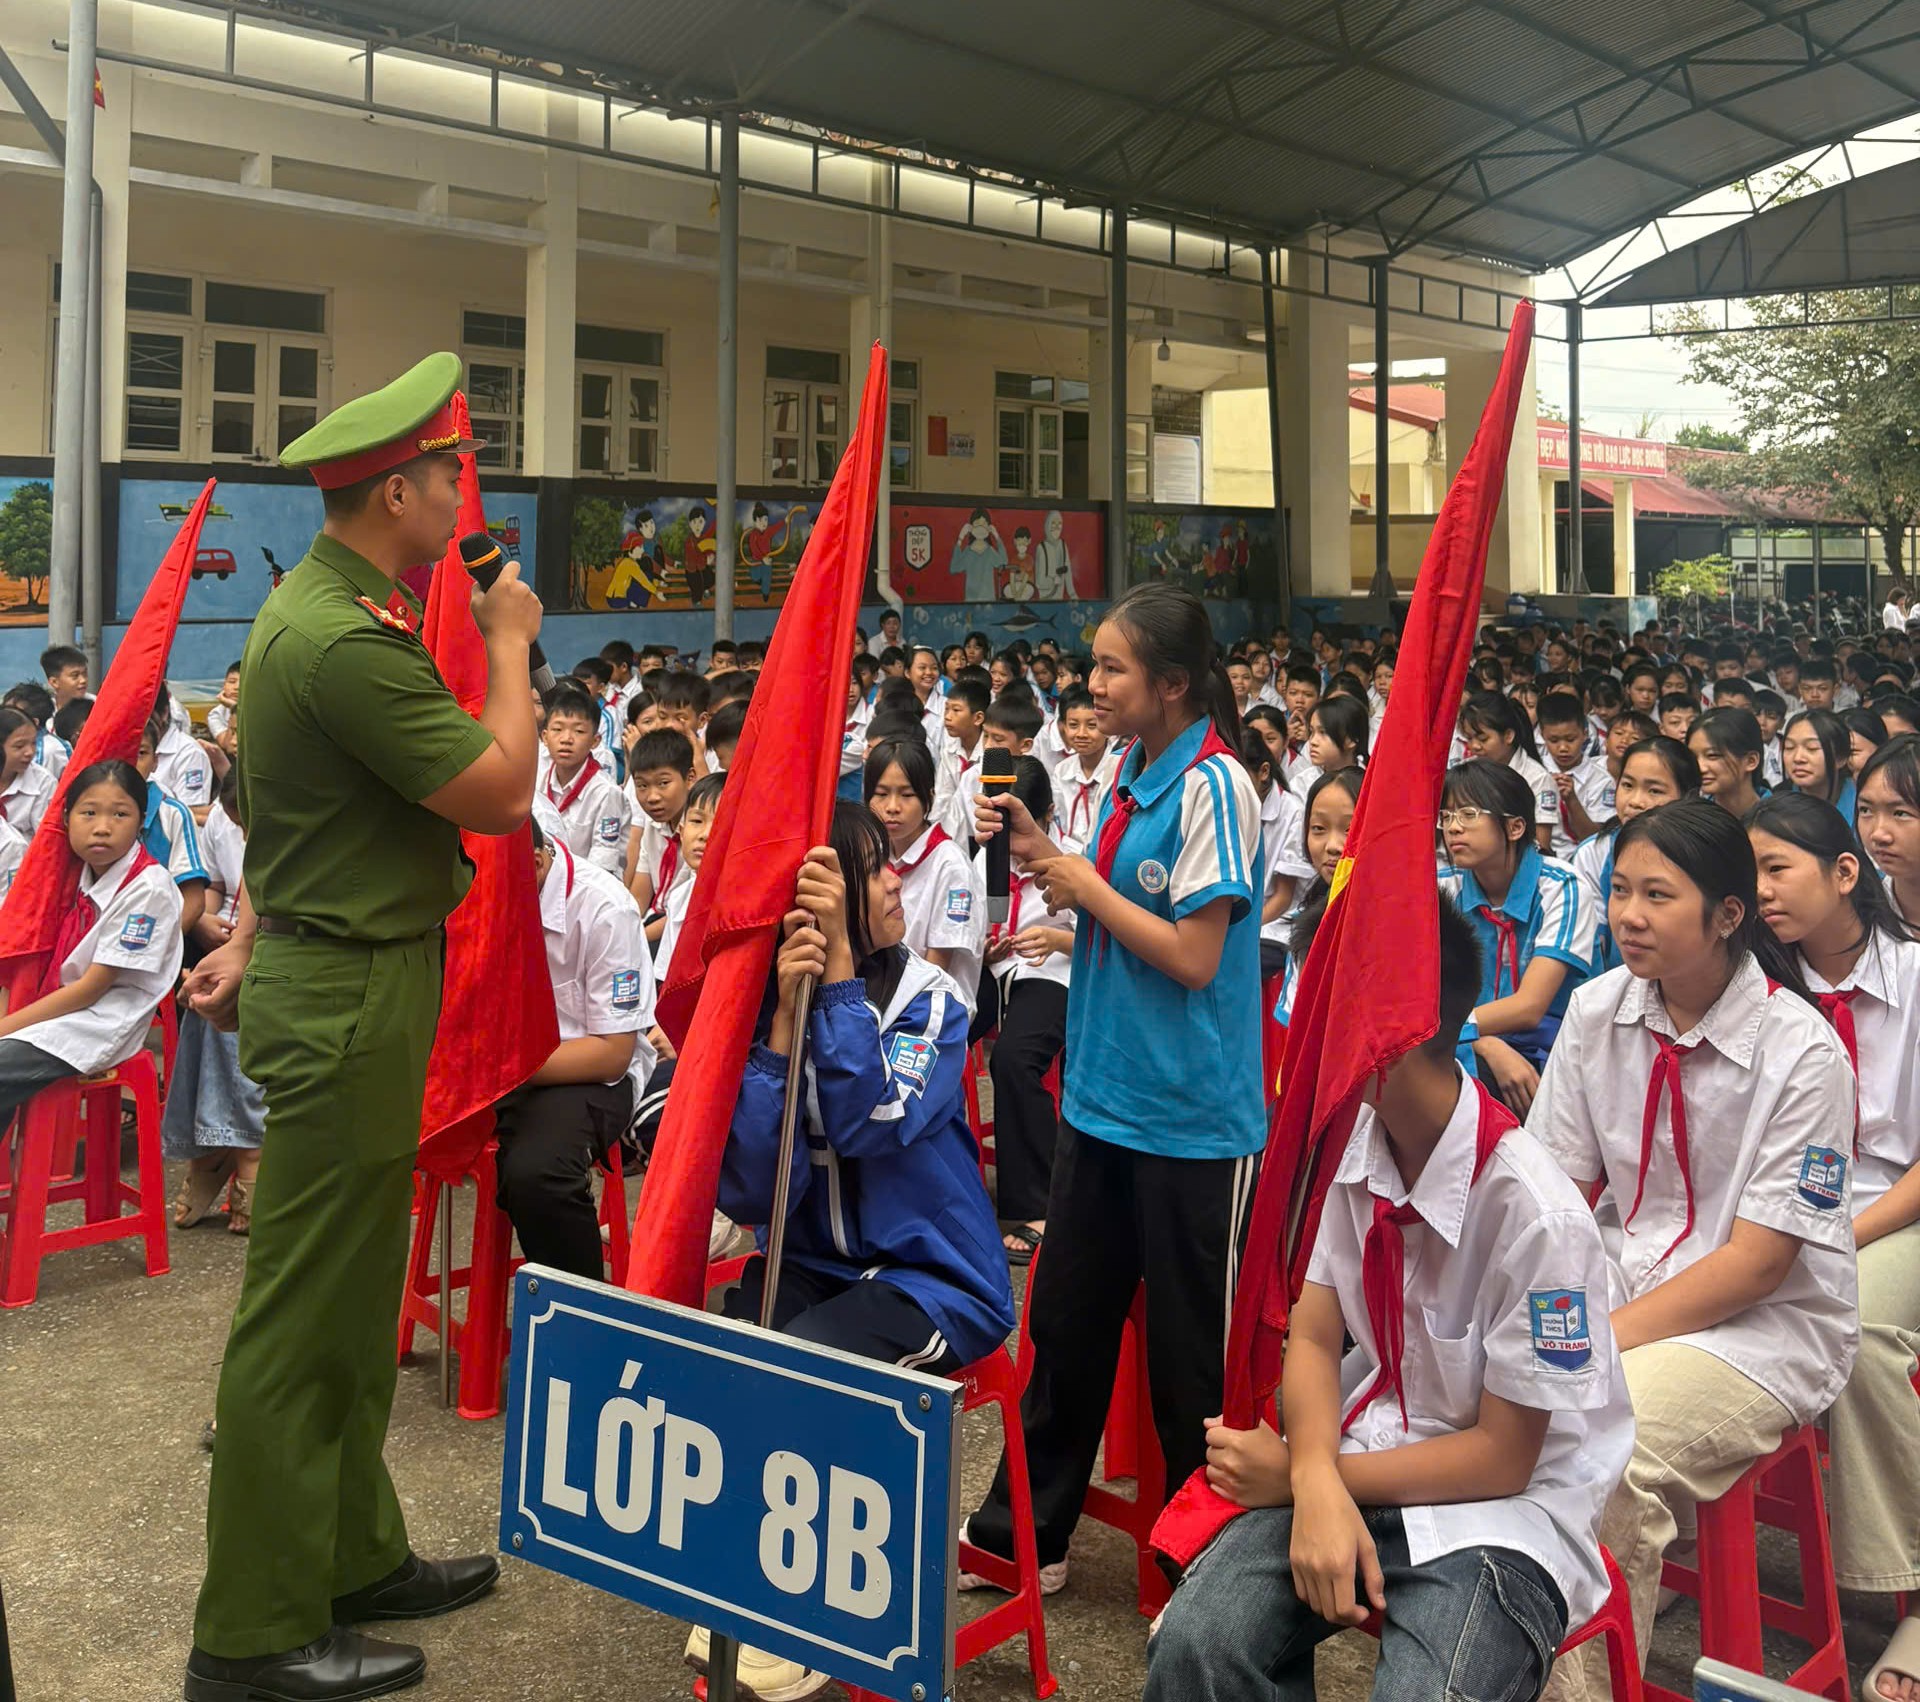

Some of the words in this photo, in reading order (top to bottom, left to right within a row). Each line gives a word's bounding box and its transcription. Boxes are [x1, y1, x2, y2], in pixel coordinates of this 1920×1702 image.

[911, 548, 926, 562] 5K
[1558, 1341, 1587, 1350] TRANH
[541, 1358, 724, 1551] LỚP
[758, 1450, 893, 1620] 8B
